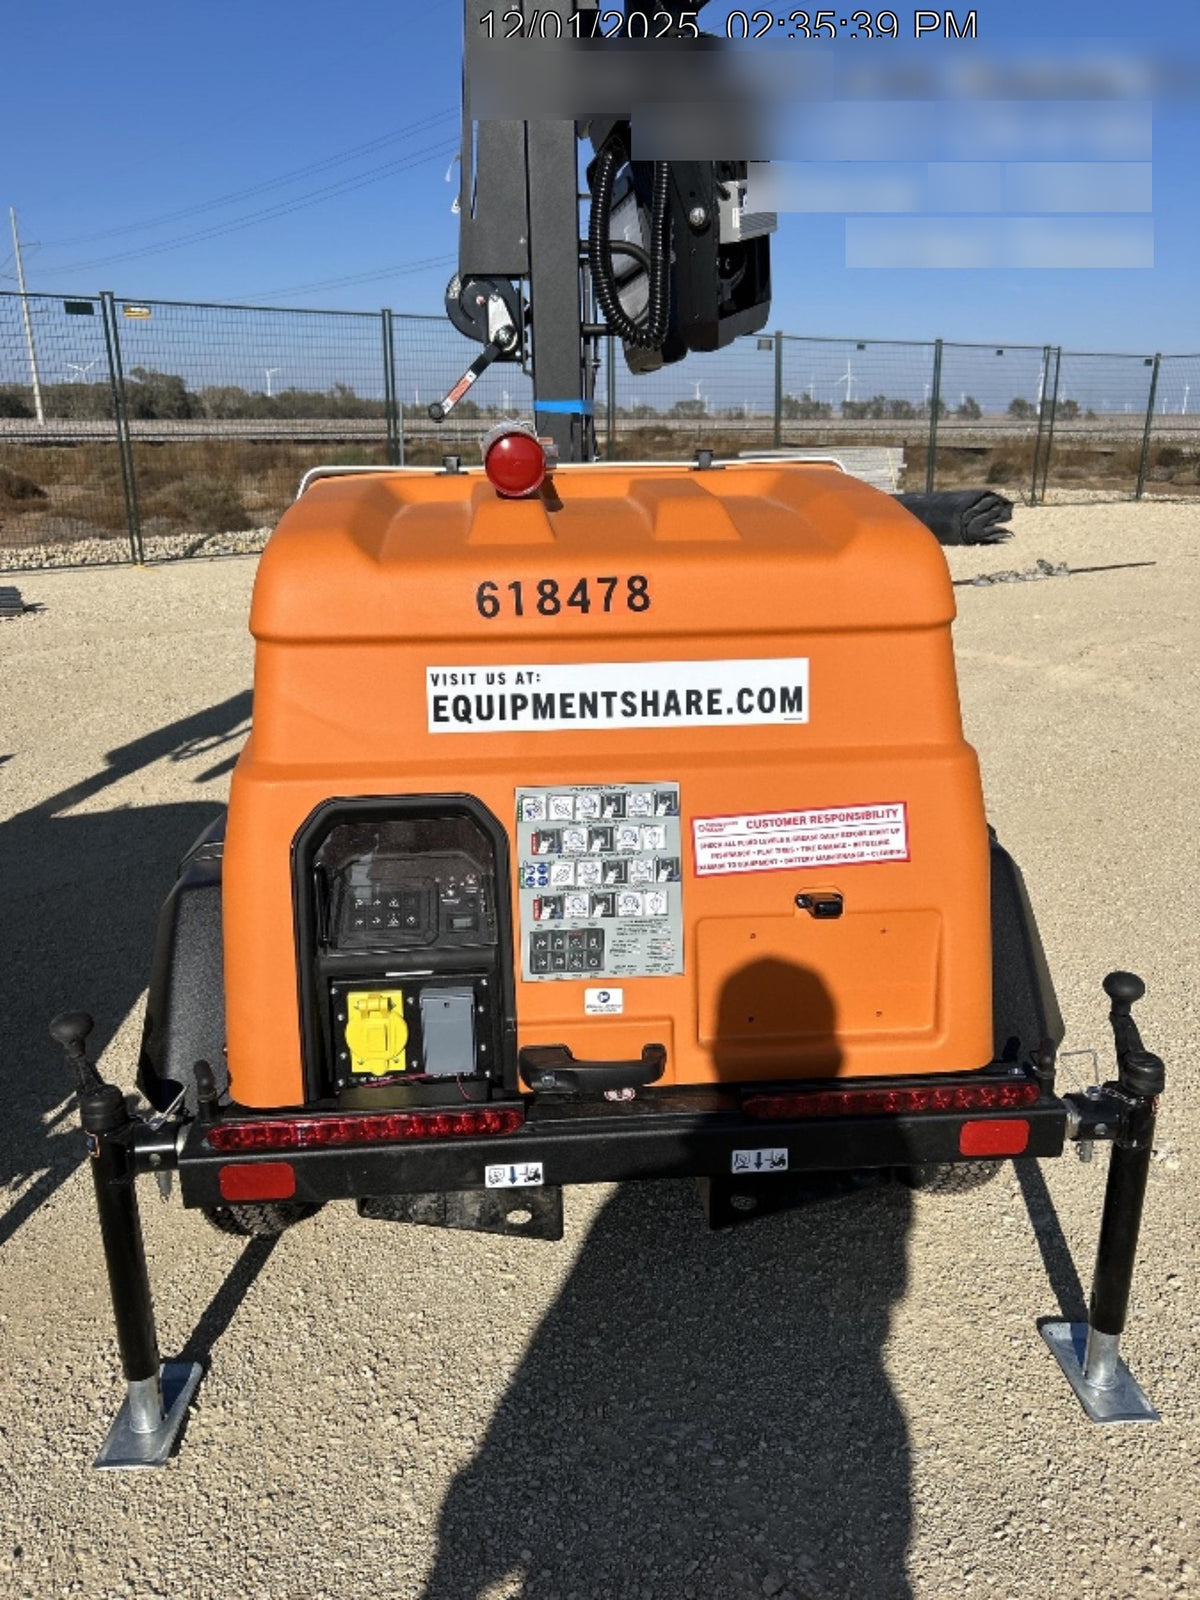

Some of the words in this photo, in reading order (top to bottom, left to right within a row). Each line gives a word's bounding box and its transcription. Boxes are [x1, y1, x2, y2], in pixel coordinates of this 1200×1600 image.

[475, 575, 651, 618] 618478
[430, 672, 476, 687] VISIT
[486, 672, 506, 685] US
[515, 671, 541, 685] AT:
[433, 686, 803, 723] EQUIPMENTSHARE.COM
[745, 815, 806, 829] CUSTOMER
[809, 808, 899, 824] RESPONSIBILITY
